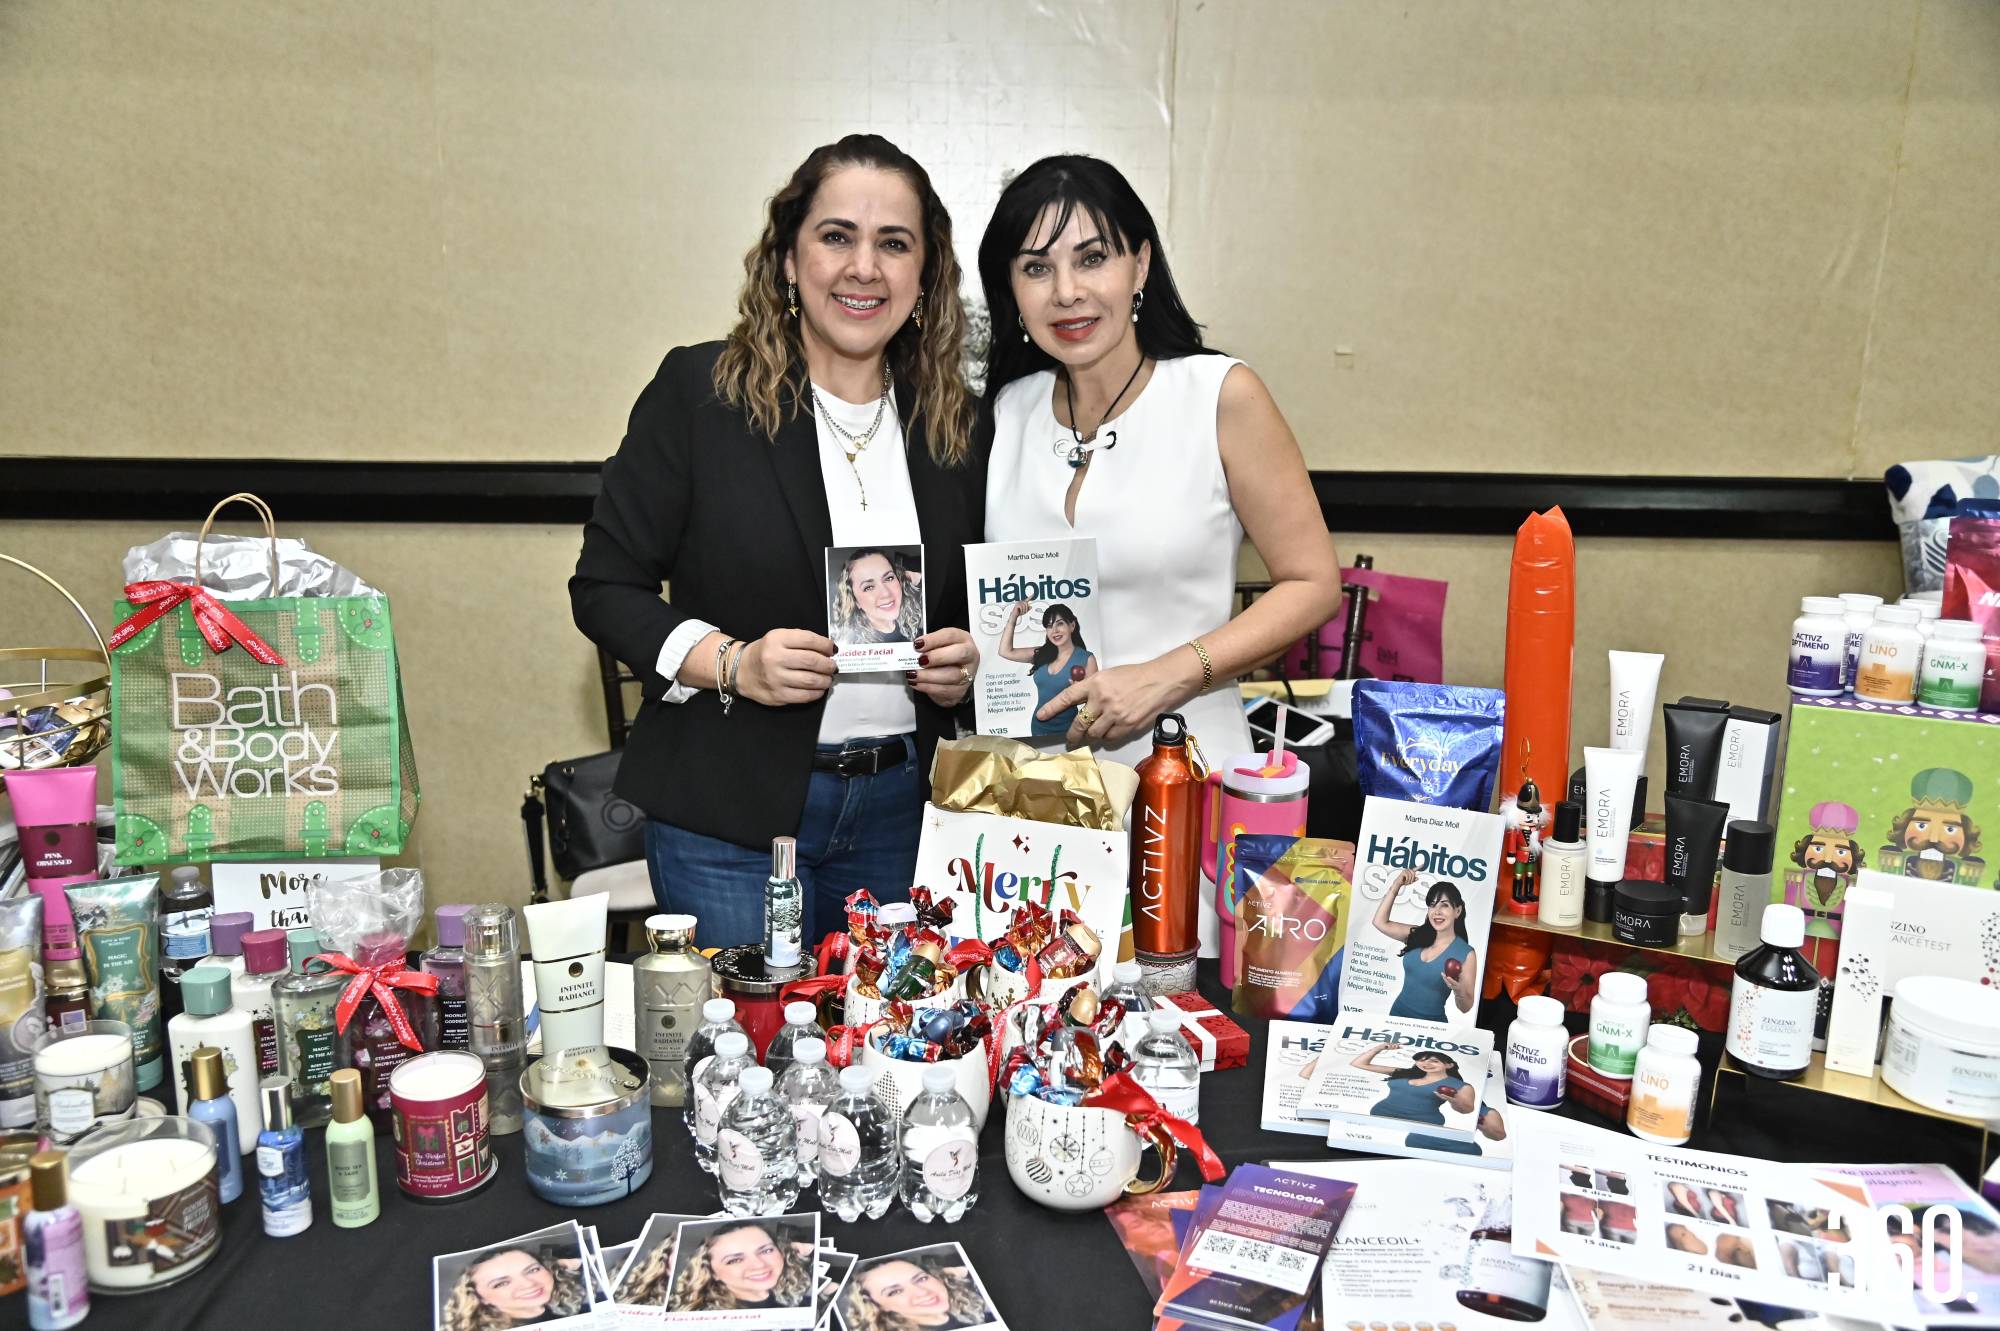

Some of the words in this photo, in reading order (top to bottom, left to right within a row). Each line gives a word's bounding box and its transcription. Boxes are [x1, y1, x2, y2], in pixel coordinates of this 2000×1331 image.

[1007, 553, 1030, 561] Martha
[1046, 551, 1060, 559] Moll
[978, 573, 1092, 604] Hábitos
[1796, 632, 1823, 642] ACTIVZ
[868, 648, 894, 656] Facial
[1930, 658, 1969, 671] GNM-X
[171, 671, 337, 729] Bath
[987, 707, 1003, 715] Mejor
[1616, 689, 1631, 737] EMORA
[177, 726, 337, 766] &Body
[1727, 728, 1742, 768] EMORA
[1380, 750, 1463, 777] Everyday
[1678, 744, 1692, 783] EMORA
[174, 760, 339, 800] Works
[1405, 814, 1428, 825] Martha
[1445, 821, 1460, 829] Moll
[1596, 788, 1611, 838] EMORA
[36, 859, 72, 867] OBSESSED
[1141, 805, 1168, 922] ACTIVZ
[1366, 834, 1488, 882] Hábitos
[1671, 836, 1687, 876] EMORA
[1559, 856, 1572, 896] EMORA
[948, 857, 1092, 915] Merry
[1731, 884, 1747, 926] EMORA
[1248, 914, 1327, 941] AIRO
[1615, 911, 1651, 929] EMORA
[1891, 934, 1952, 952] ANCETEST
[1370, 955, 1389, 964] poder
[1349, 966, 1372, 976] Nuevos
[558, 989, 596, 1001] RADIANCE
[560, 981, 593, 993] INFINITE
[1347, 981, 1364, 991] Mejor
[1596, 1023, 1633, 1038] GNM-X
[1341, 1026, 1480, 1056] Hábitos
[1513, 1042, 1540, 1056] ACTIVZ
[1645, 1153, 1749, 1178] TESTIMONIOS
[1274, 1177, 1317, 1190] ACTIVZ
[1332, 1236, 1422, 1246] LANCEOIL+
[1686, 1262, 1704, 1274] 21
